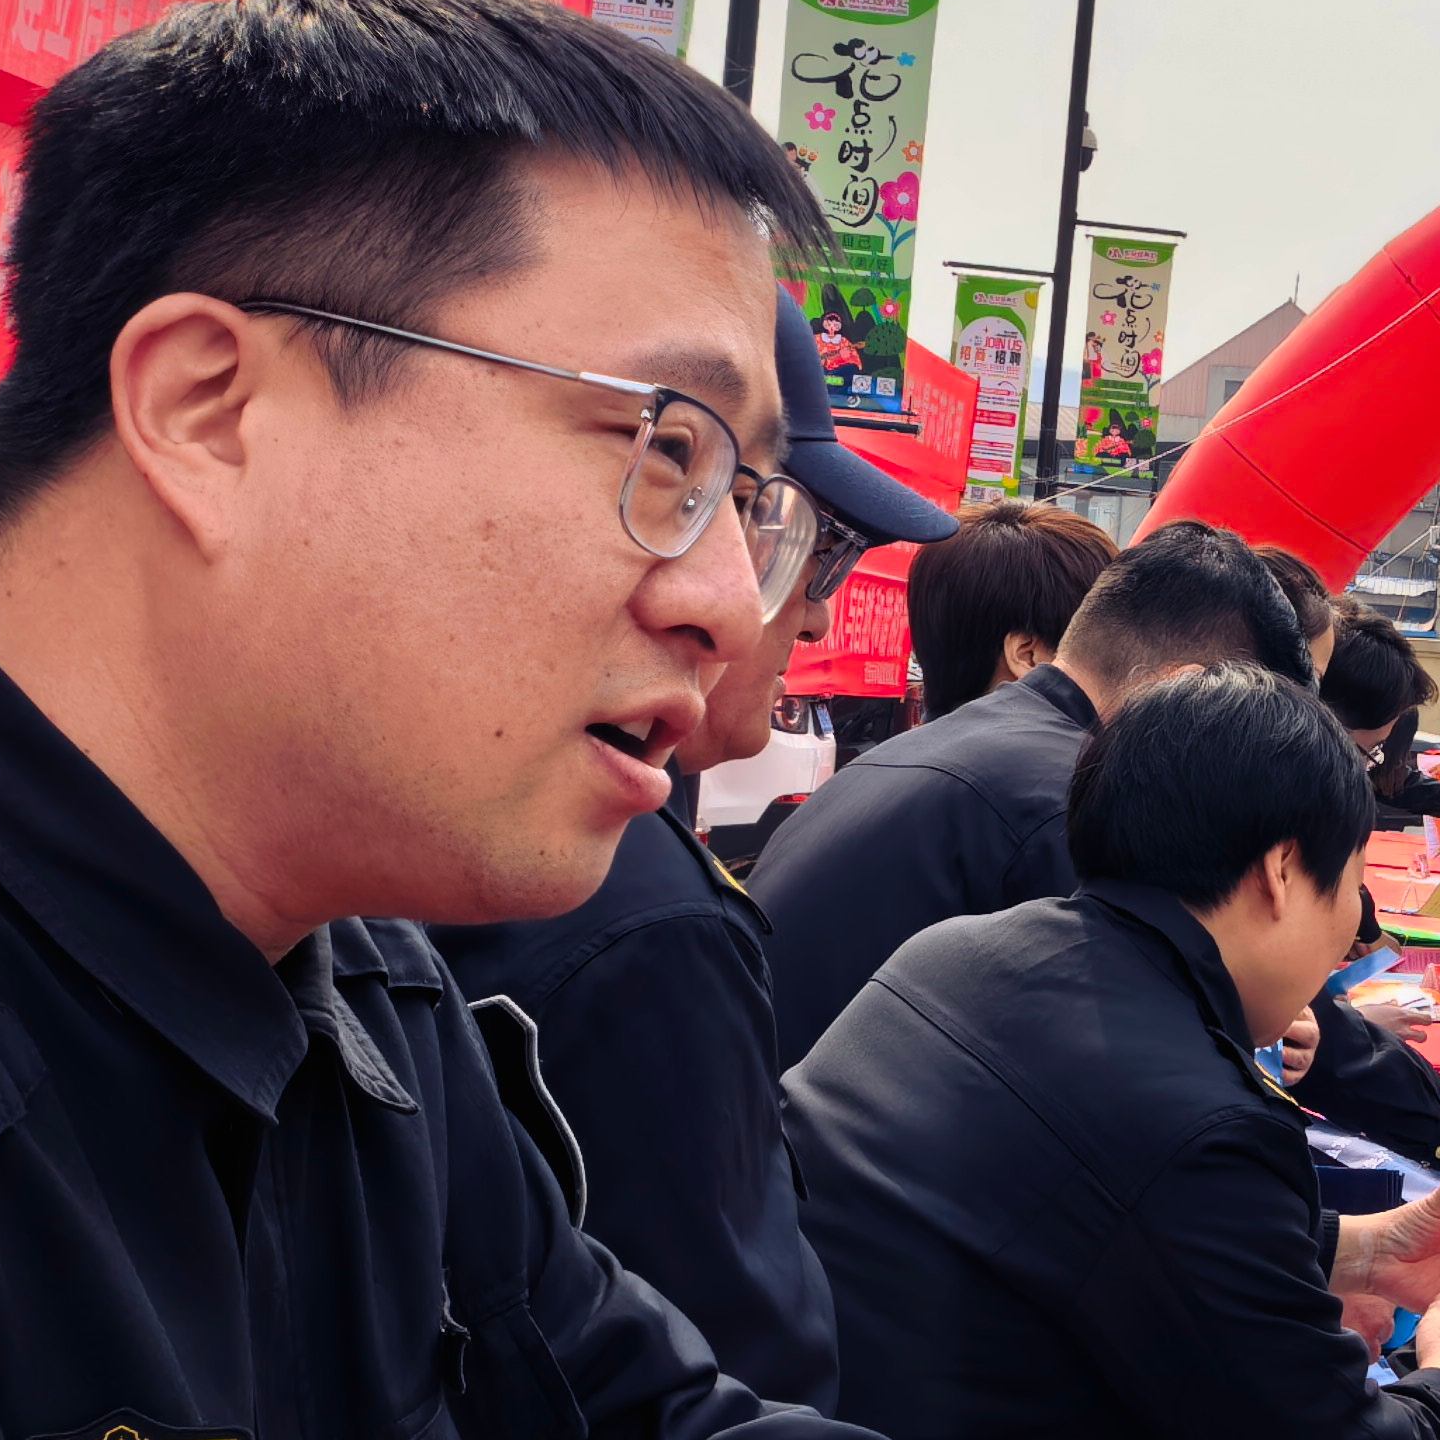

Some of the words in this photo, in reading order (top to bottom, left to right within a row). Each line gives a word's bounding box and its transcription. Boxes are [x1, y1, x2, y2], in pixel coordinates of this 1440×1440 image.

[791, 38, 901, 227] 花点时间
[985, 336, 1005, 349] JOIN
[1008, 340, 1022, 351] US
[1093, 276, 1153, 377] 花点时间
